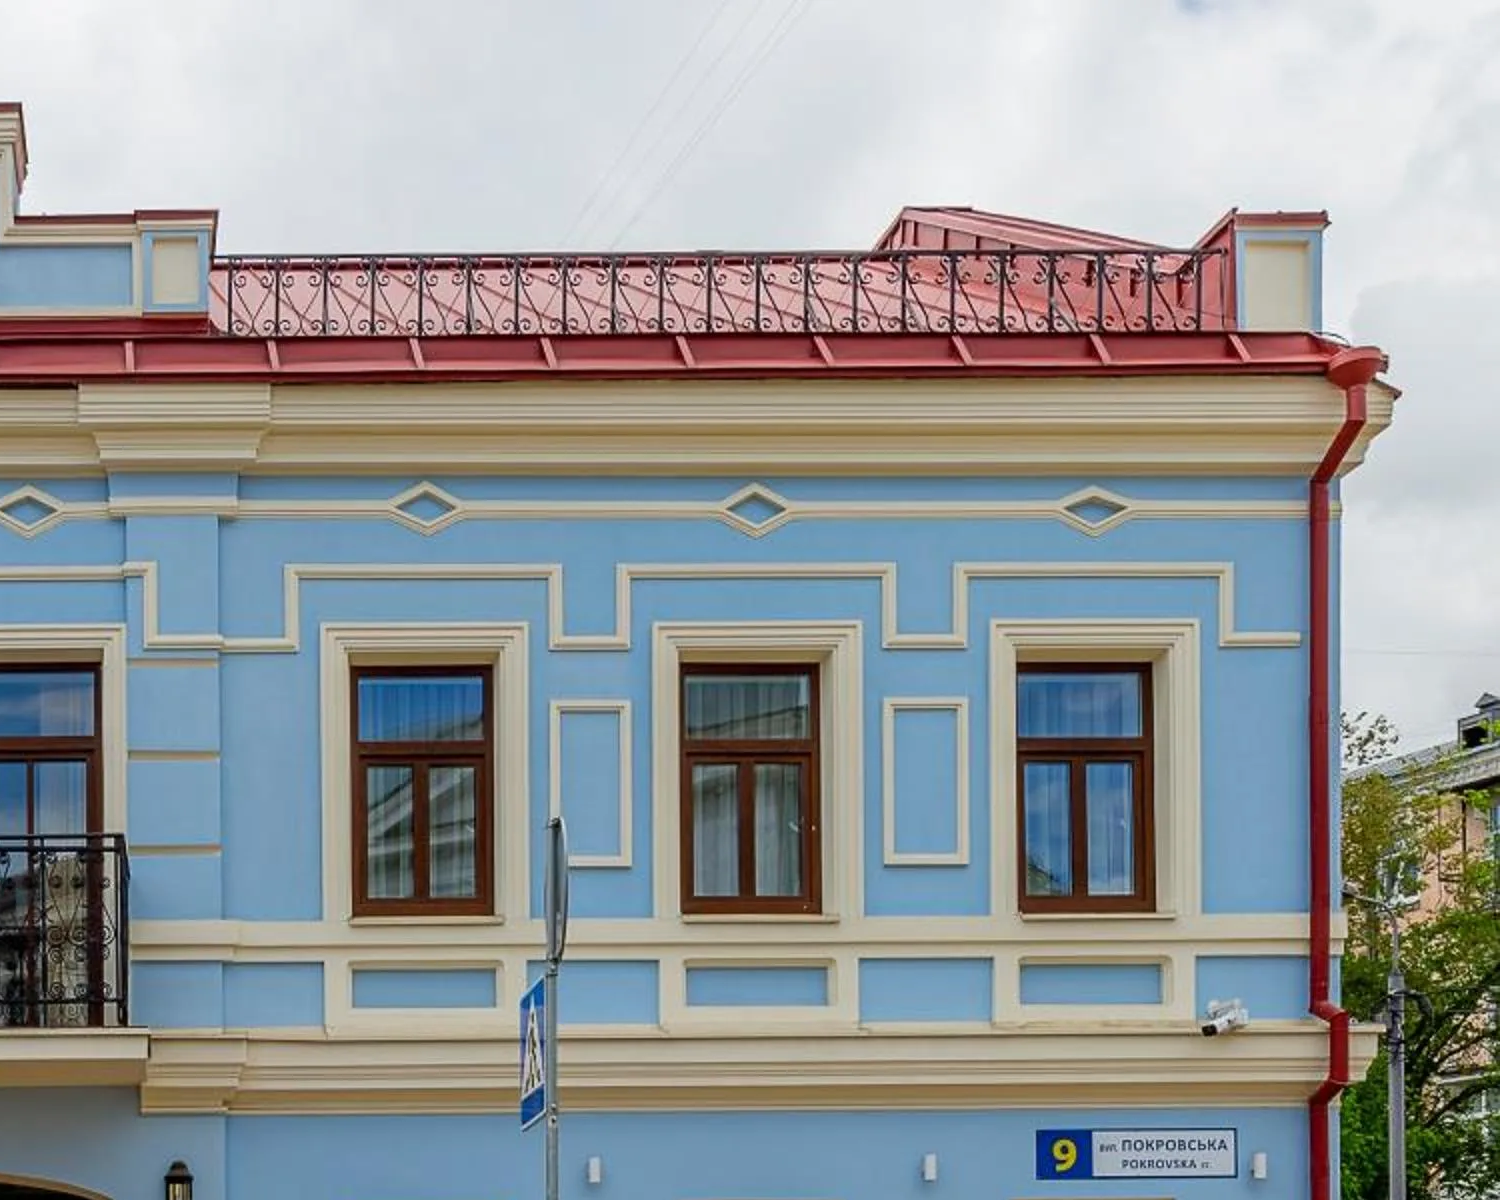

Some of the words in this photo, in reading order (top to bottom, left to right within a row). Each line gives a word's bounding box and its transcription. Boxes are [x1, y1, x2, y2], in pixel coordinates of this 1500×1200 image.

[1121, 1139, 1229, 1151] ПОКРОВСЬКА
[1052, 1138, 1077, 1172] 9
[1121, 1159, 1197, 1169] POKROVSKA
